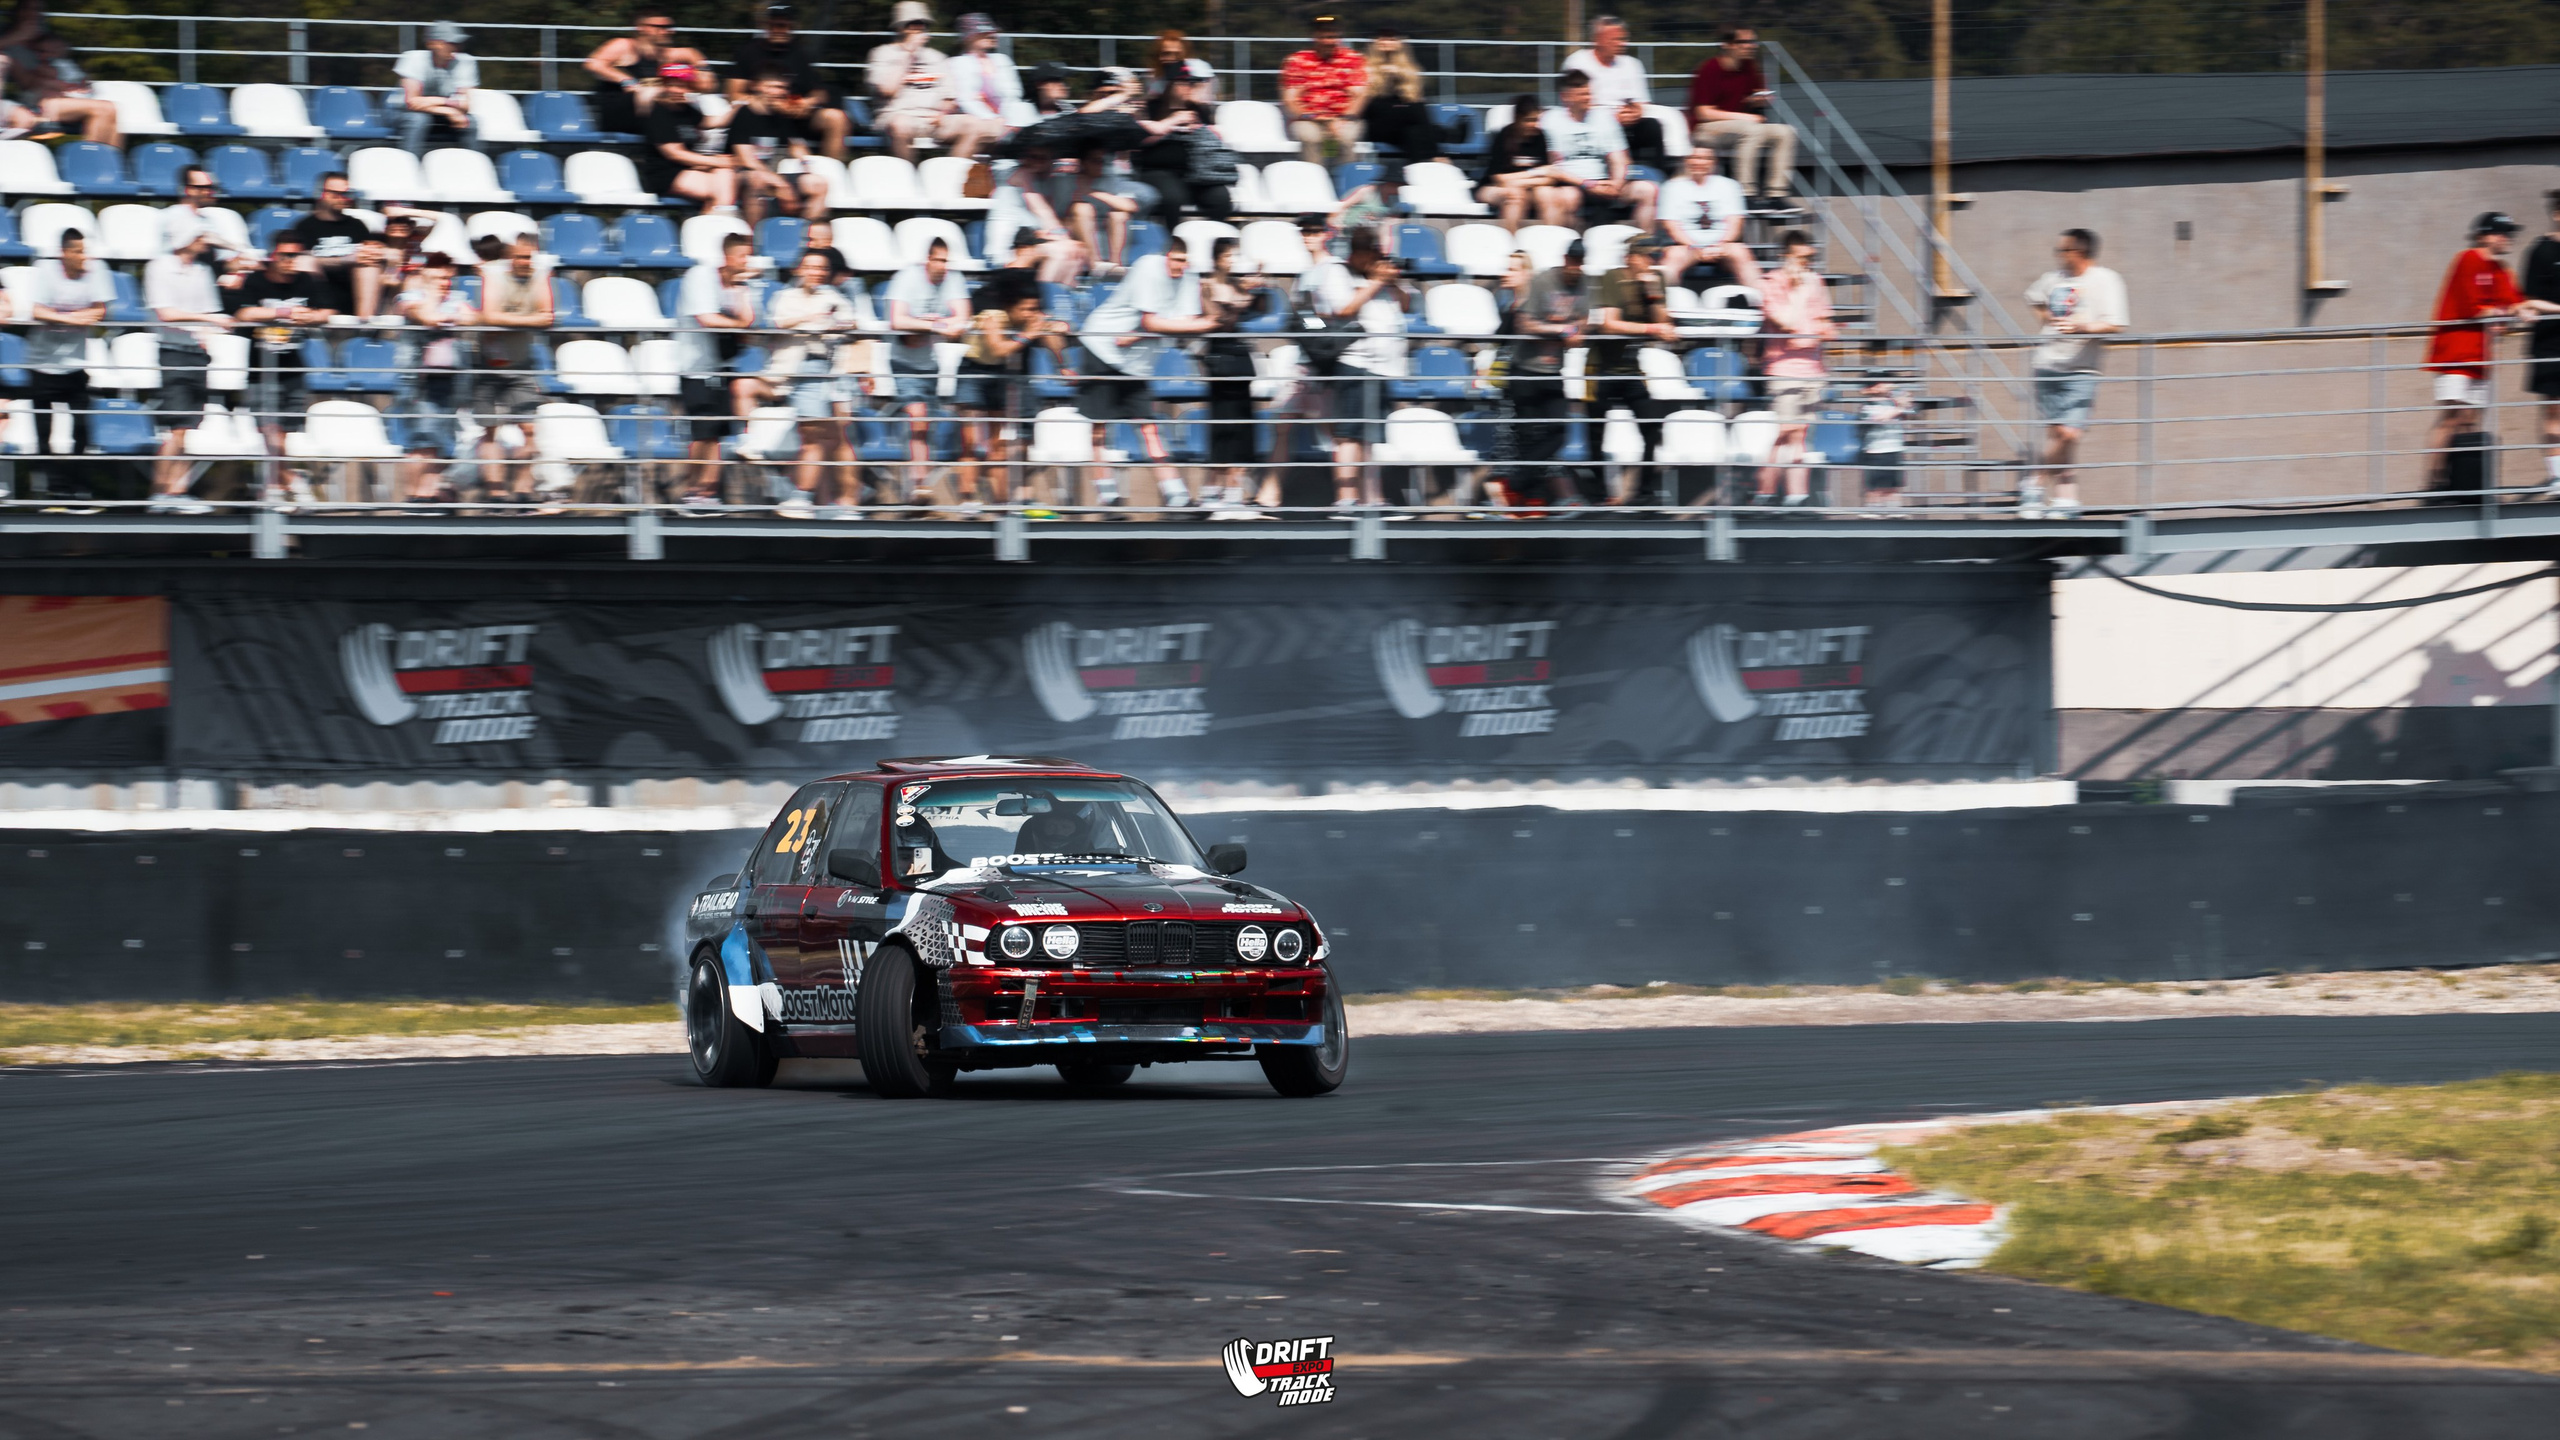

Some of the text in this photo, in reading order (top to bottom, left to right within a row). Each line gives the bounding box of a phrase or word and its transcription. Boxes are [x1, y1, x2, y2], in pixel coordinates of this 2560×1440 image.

[396, 624, 539, 669] DRIFT
[762, 625, 900, 669] DRIFT
[1077, 623, 1213, 666] DRIFT
[1426, 620, 1560, 664] DRIFT
[1738, 625, 1874, 668] DRIFT
[775, 808, 817, 853] 23
[1045, 935, 1077, 946] Hella
[1240, 937, 1266, 947] Hella
